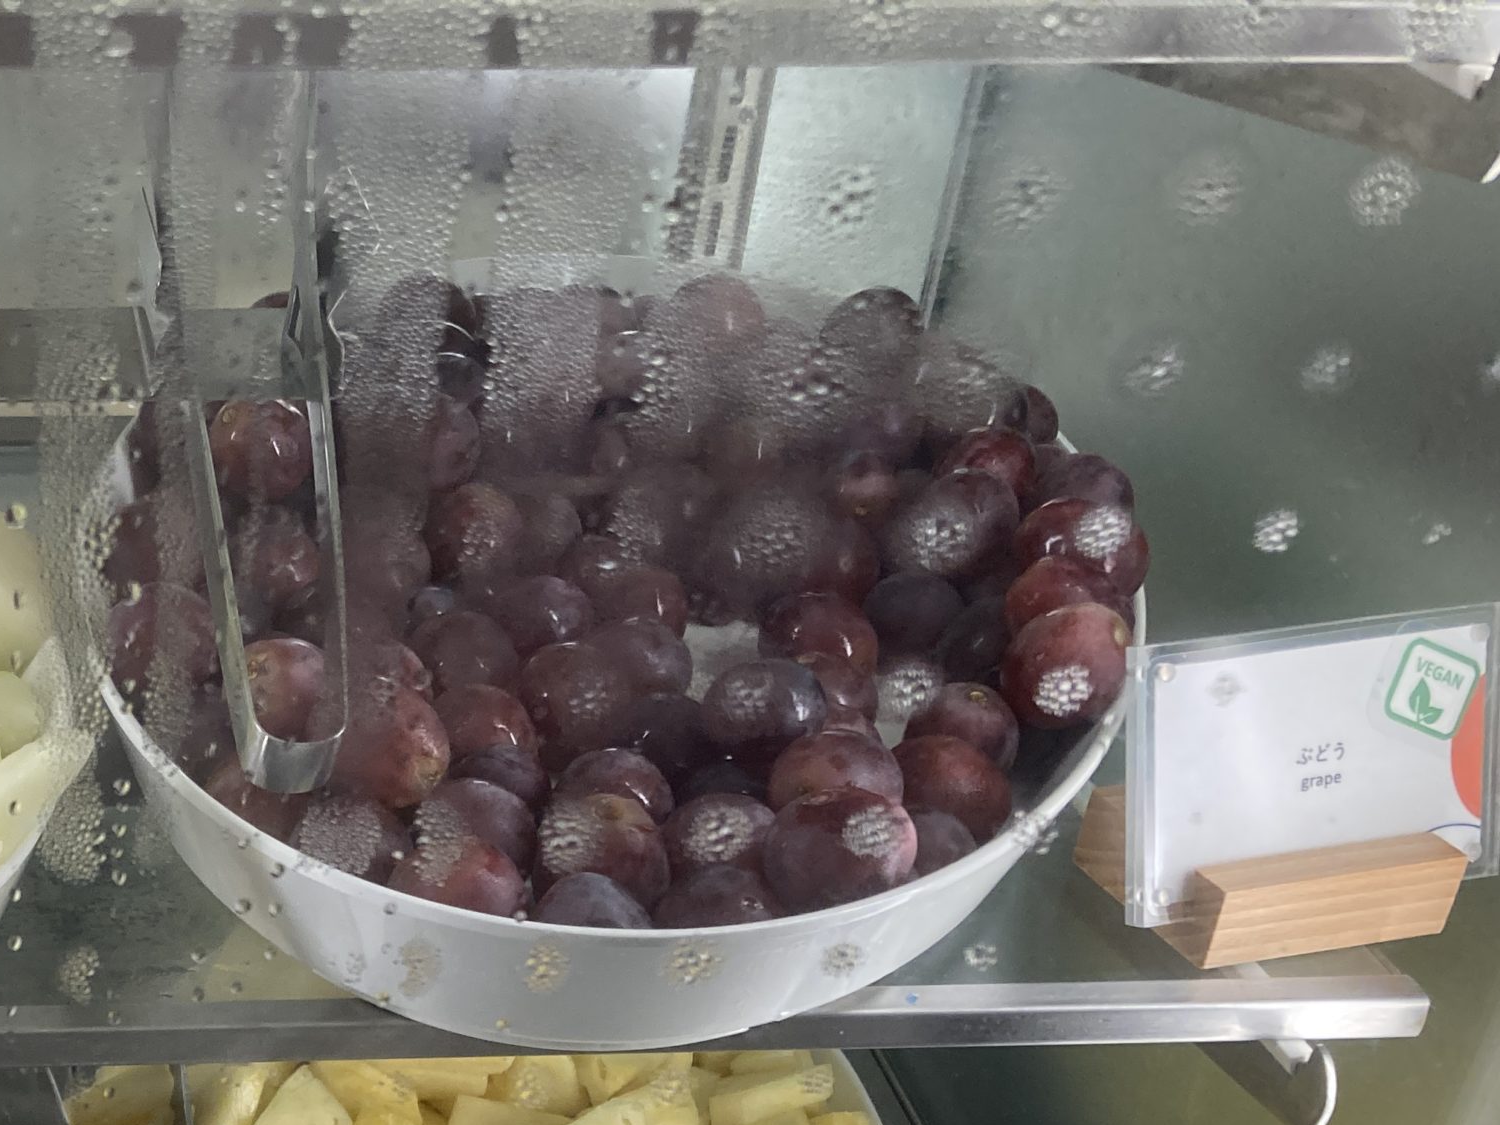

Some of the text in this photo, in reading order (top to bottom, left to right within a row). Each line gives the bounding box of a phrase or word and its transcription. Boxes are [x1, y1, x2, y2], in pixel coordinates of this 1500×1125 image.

[1416, 656, 1465, 691] VEGAN
[1296, 742, 1345, 765] ぶどう
[1301, 773, 1342, 792] grape
